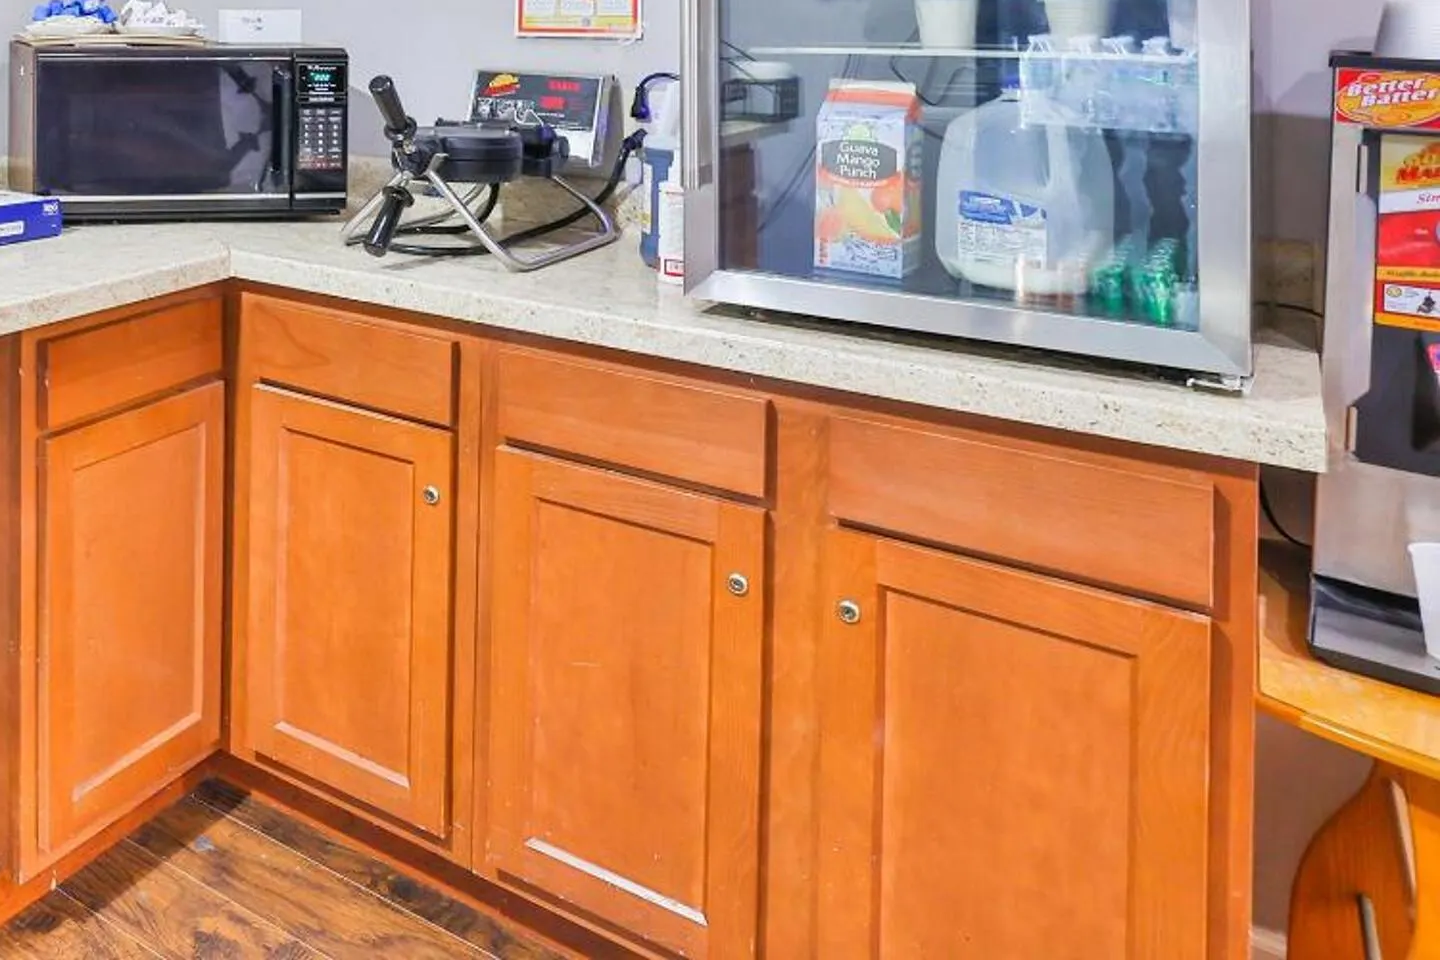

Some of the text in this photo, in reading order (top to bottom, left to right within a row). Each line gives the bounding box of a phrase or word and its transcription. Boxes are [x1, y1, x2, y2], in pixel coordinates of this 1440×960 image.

[1347, 78, 1425, 97] Better
[1361, 89, 1438, 108] Batter
[840, 141, 879, 157] Guava
[836, 153, 881, 169] Mango
[840, 165, 877, 180] Punch
